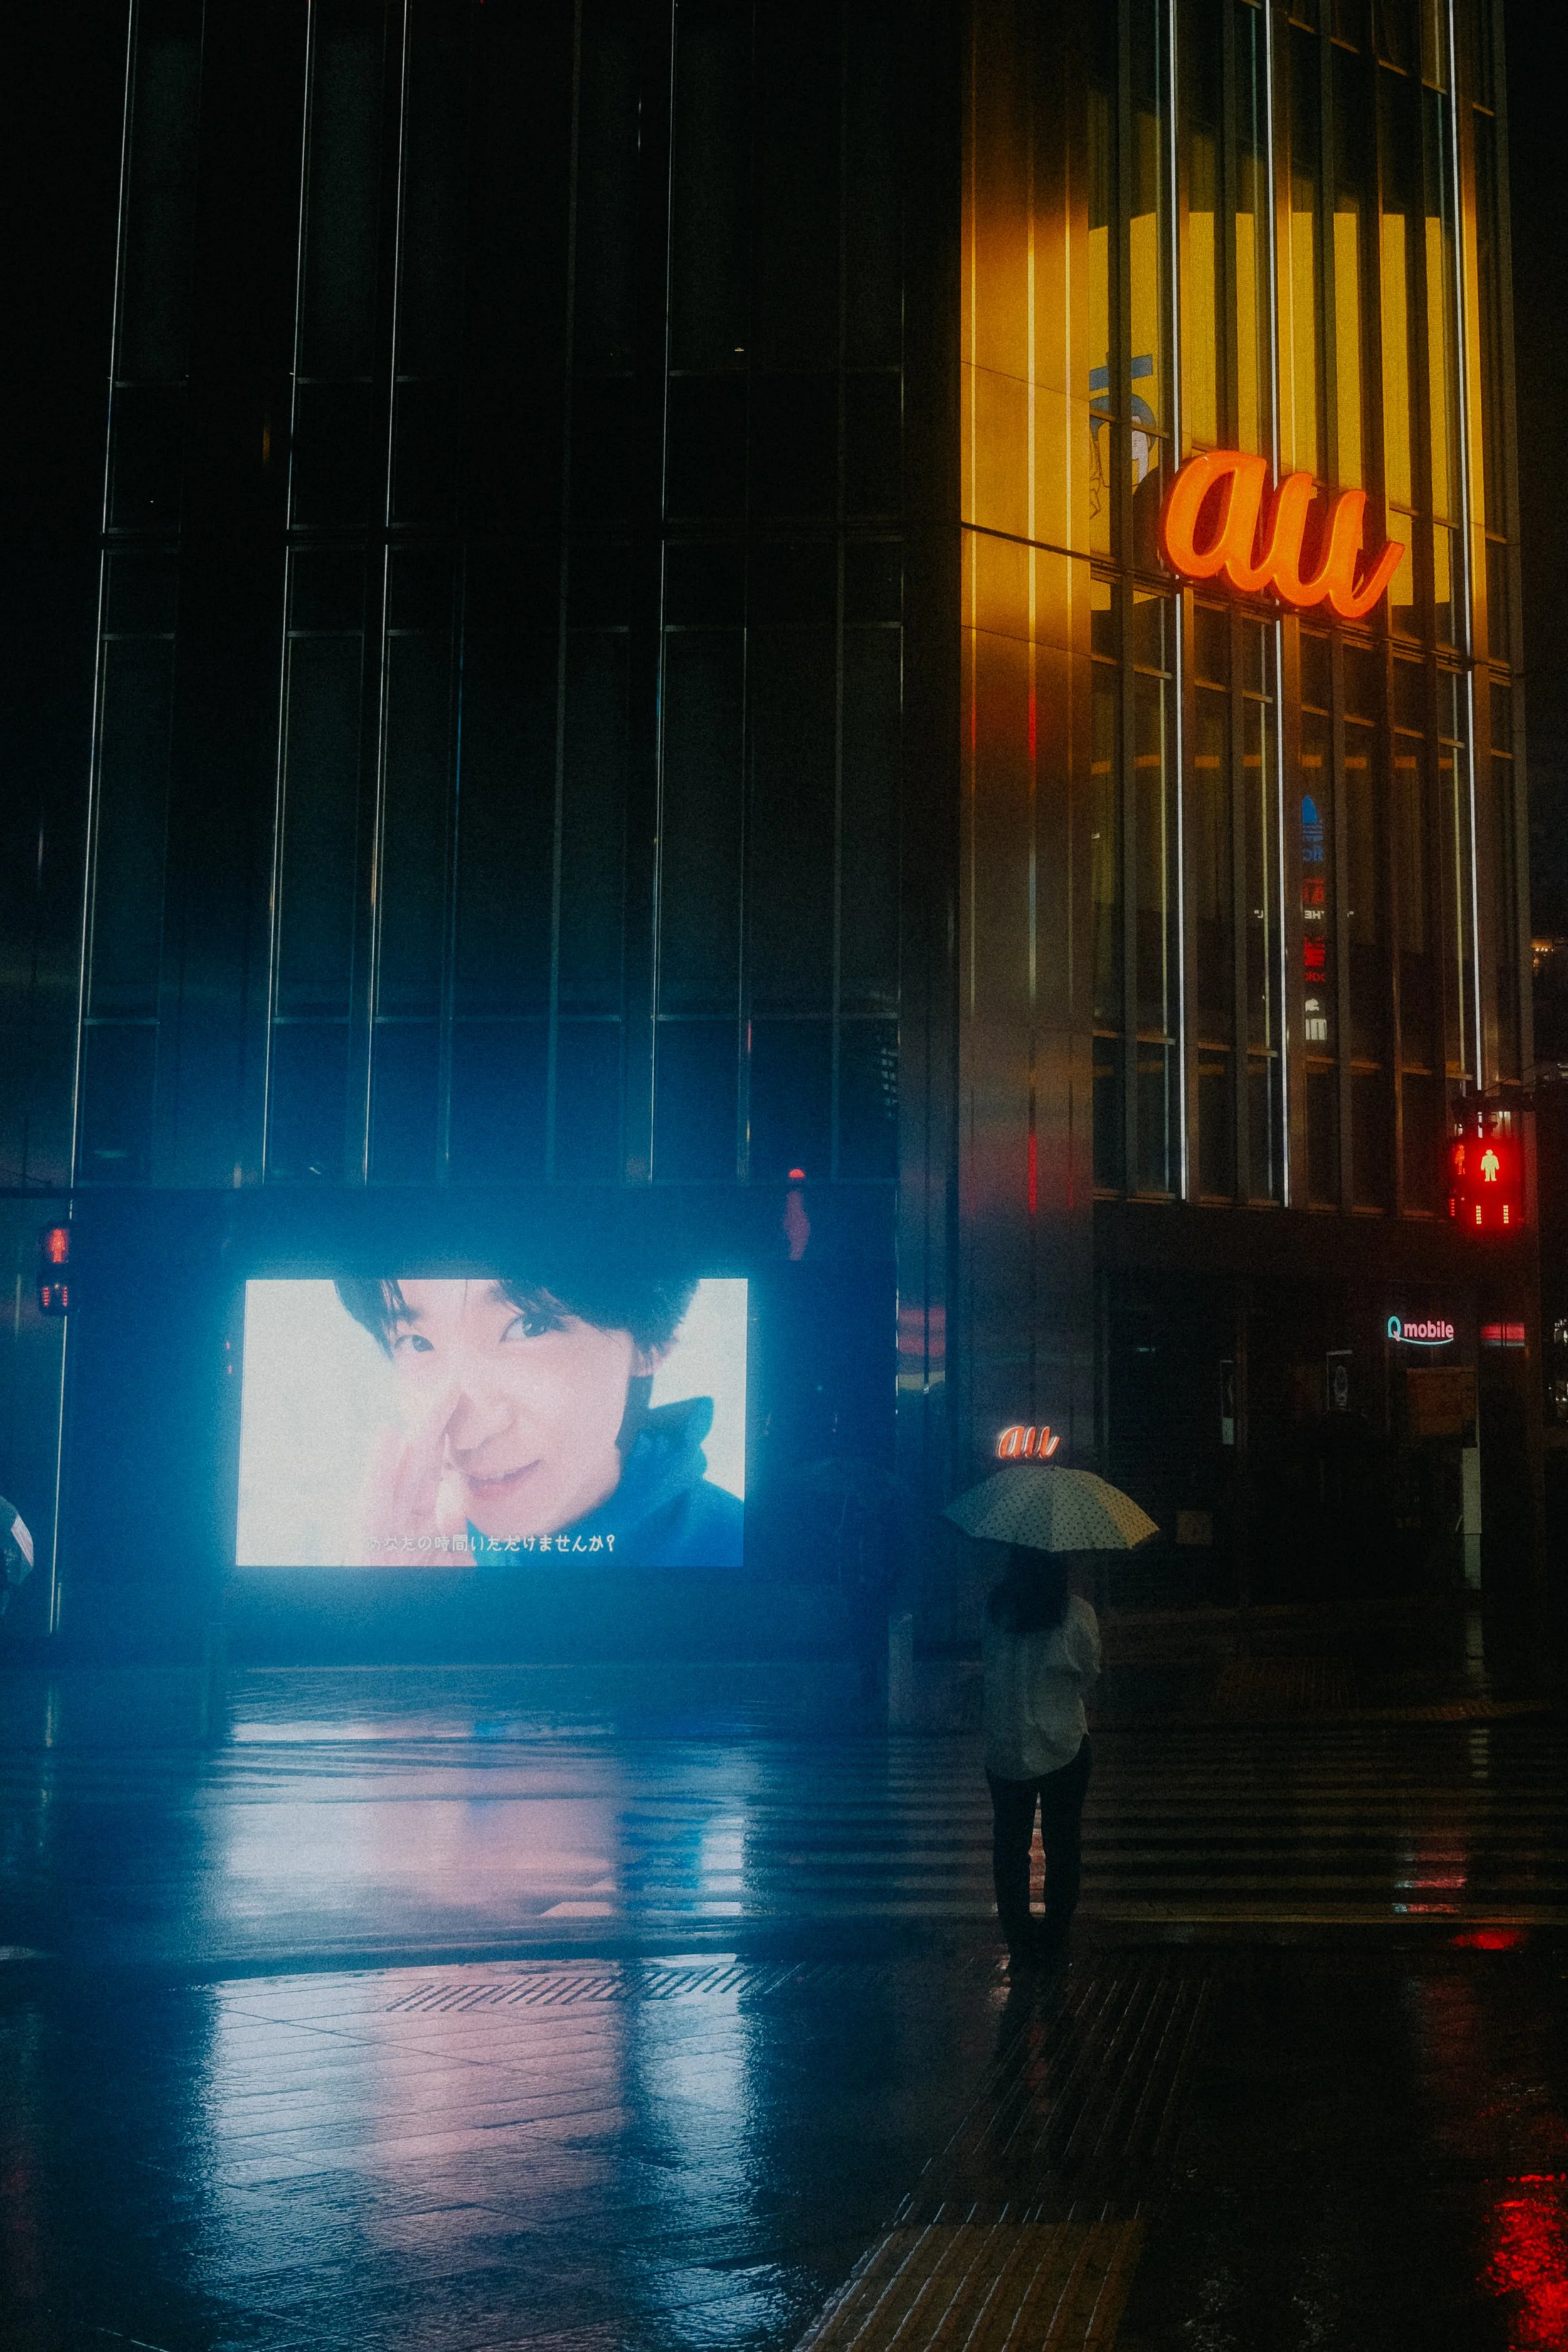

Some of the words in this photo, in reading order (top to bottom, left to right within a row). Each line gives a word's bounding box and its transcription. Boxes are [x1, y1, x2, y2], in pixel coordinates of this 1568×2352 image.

[1165, 450, 1406, 618] au
[1404, 1320, 1454, 1338] mobile
[998, 1426, 1060, 1459] au
